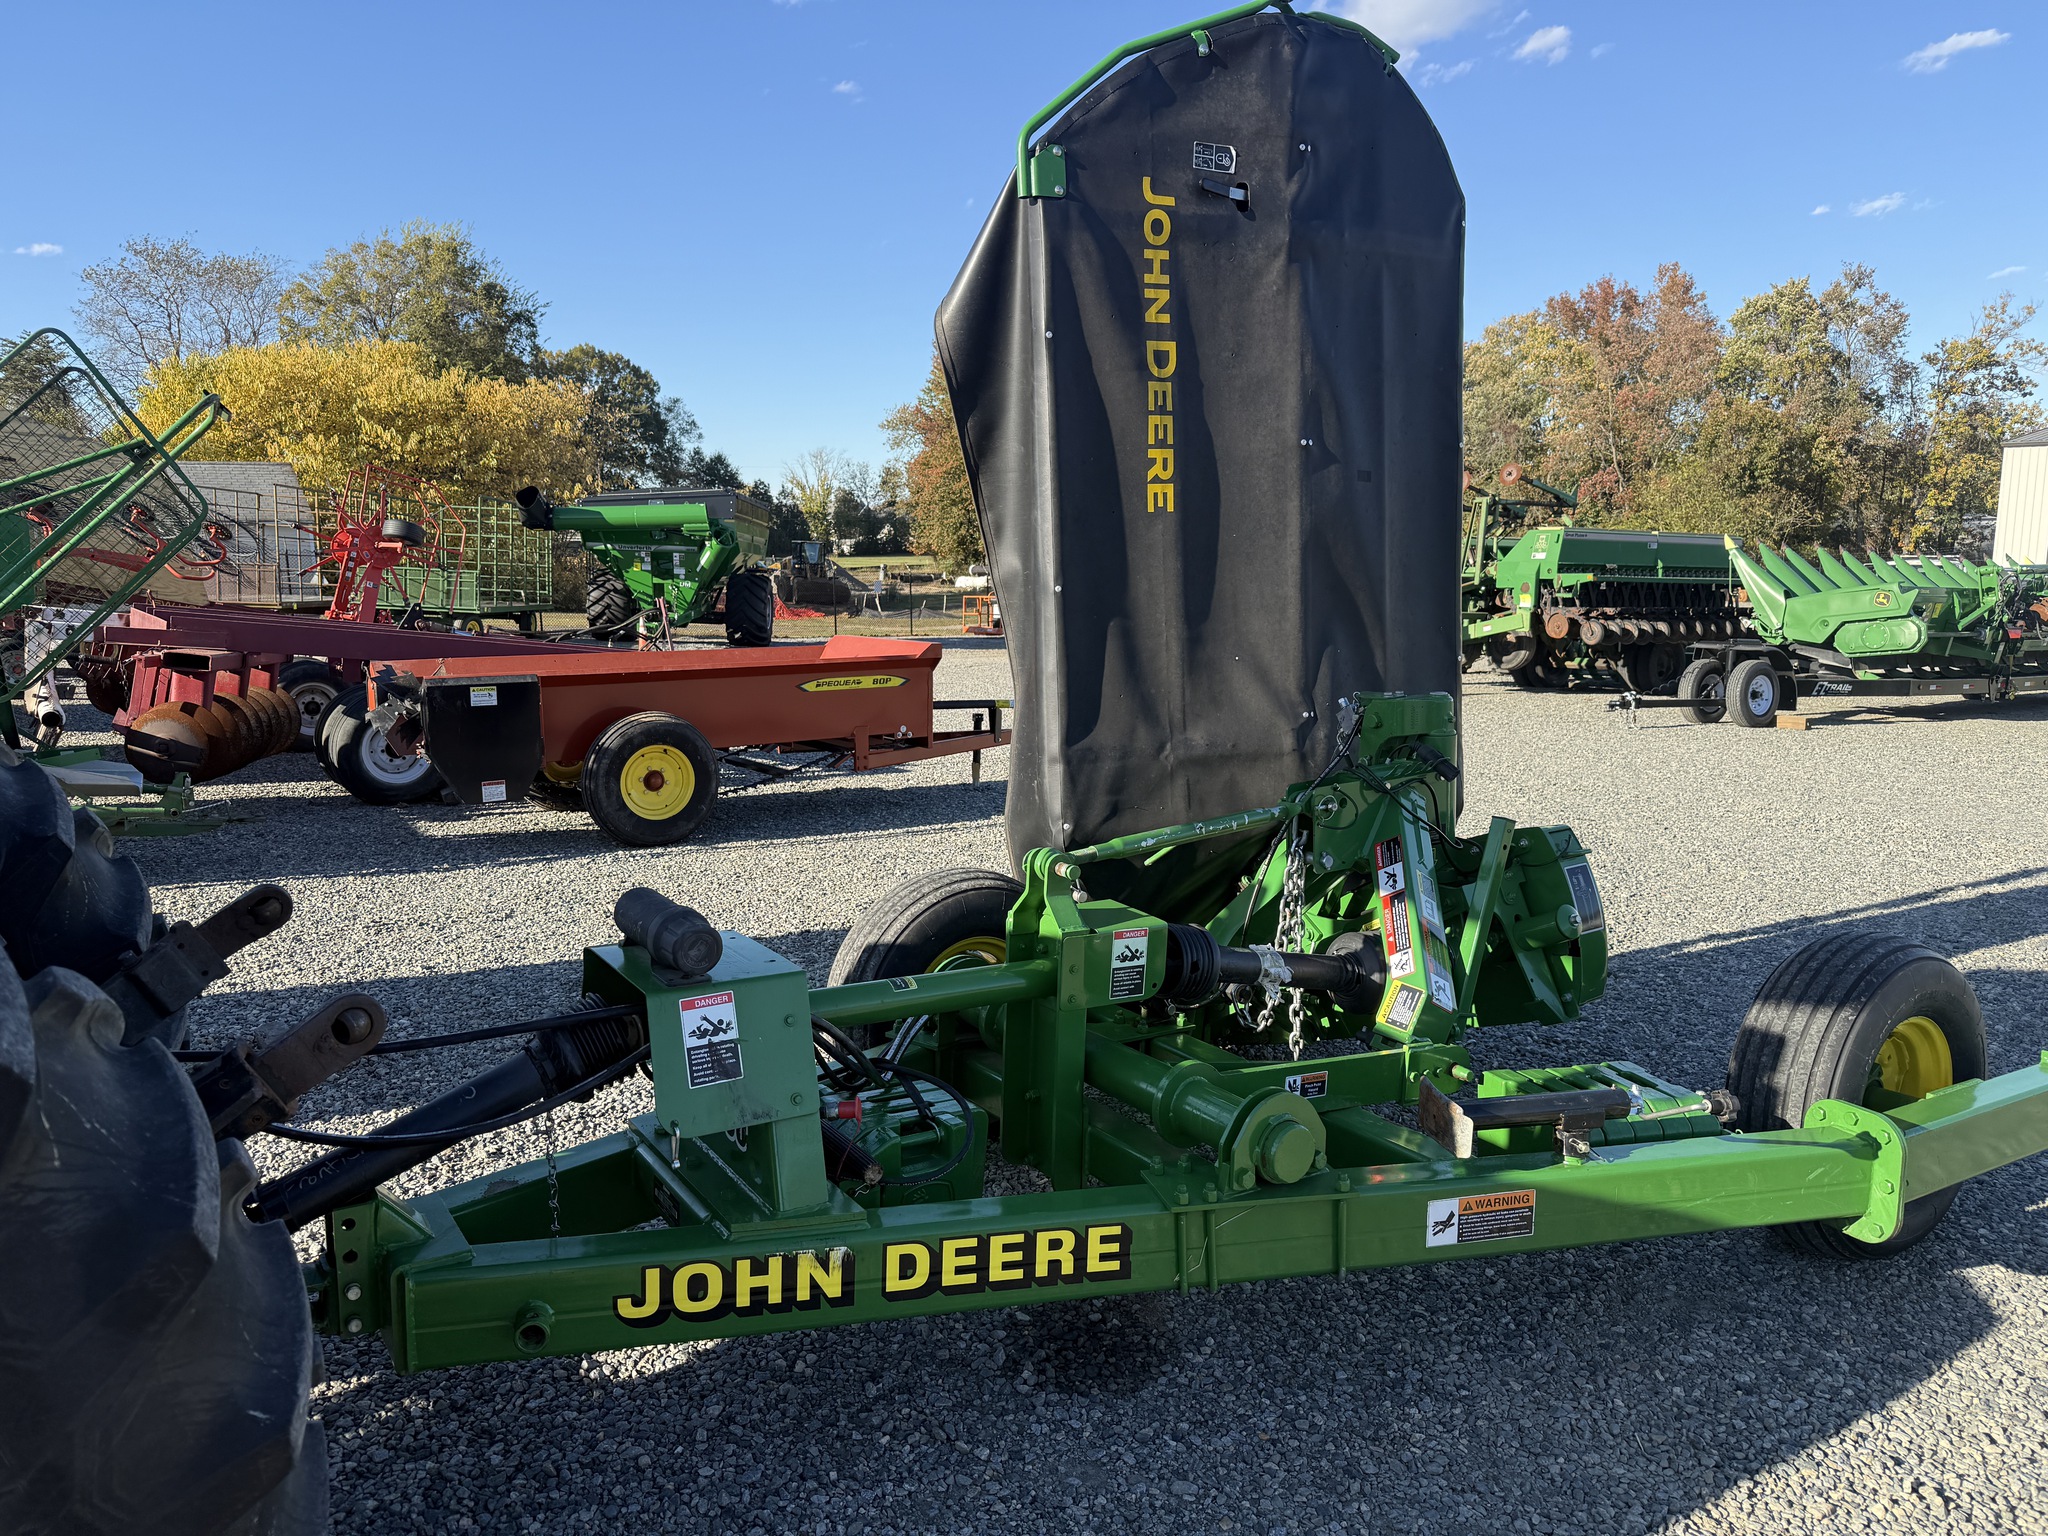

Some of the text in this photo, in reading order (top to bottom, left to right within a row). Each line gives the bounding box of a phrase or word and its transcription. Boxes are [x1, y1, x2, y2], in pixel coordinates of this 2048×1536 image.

[1142, 176, 1178, 513] JOHN DEERE
[821, 677, 892, 687] PEQUEA 80P
[1384, 908, 1393, 934] DANGER
[1122, 930, 1145, 938] DANGER
[694, 995, 729, 1008] DANGER
[1384, 984, 1399, 1014] CAUTION
[1475, 1194, 1530, 1210] WARNING
[616, 1225, 1123, 1321] JOHN DEERE
